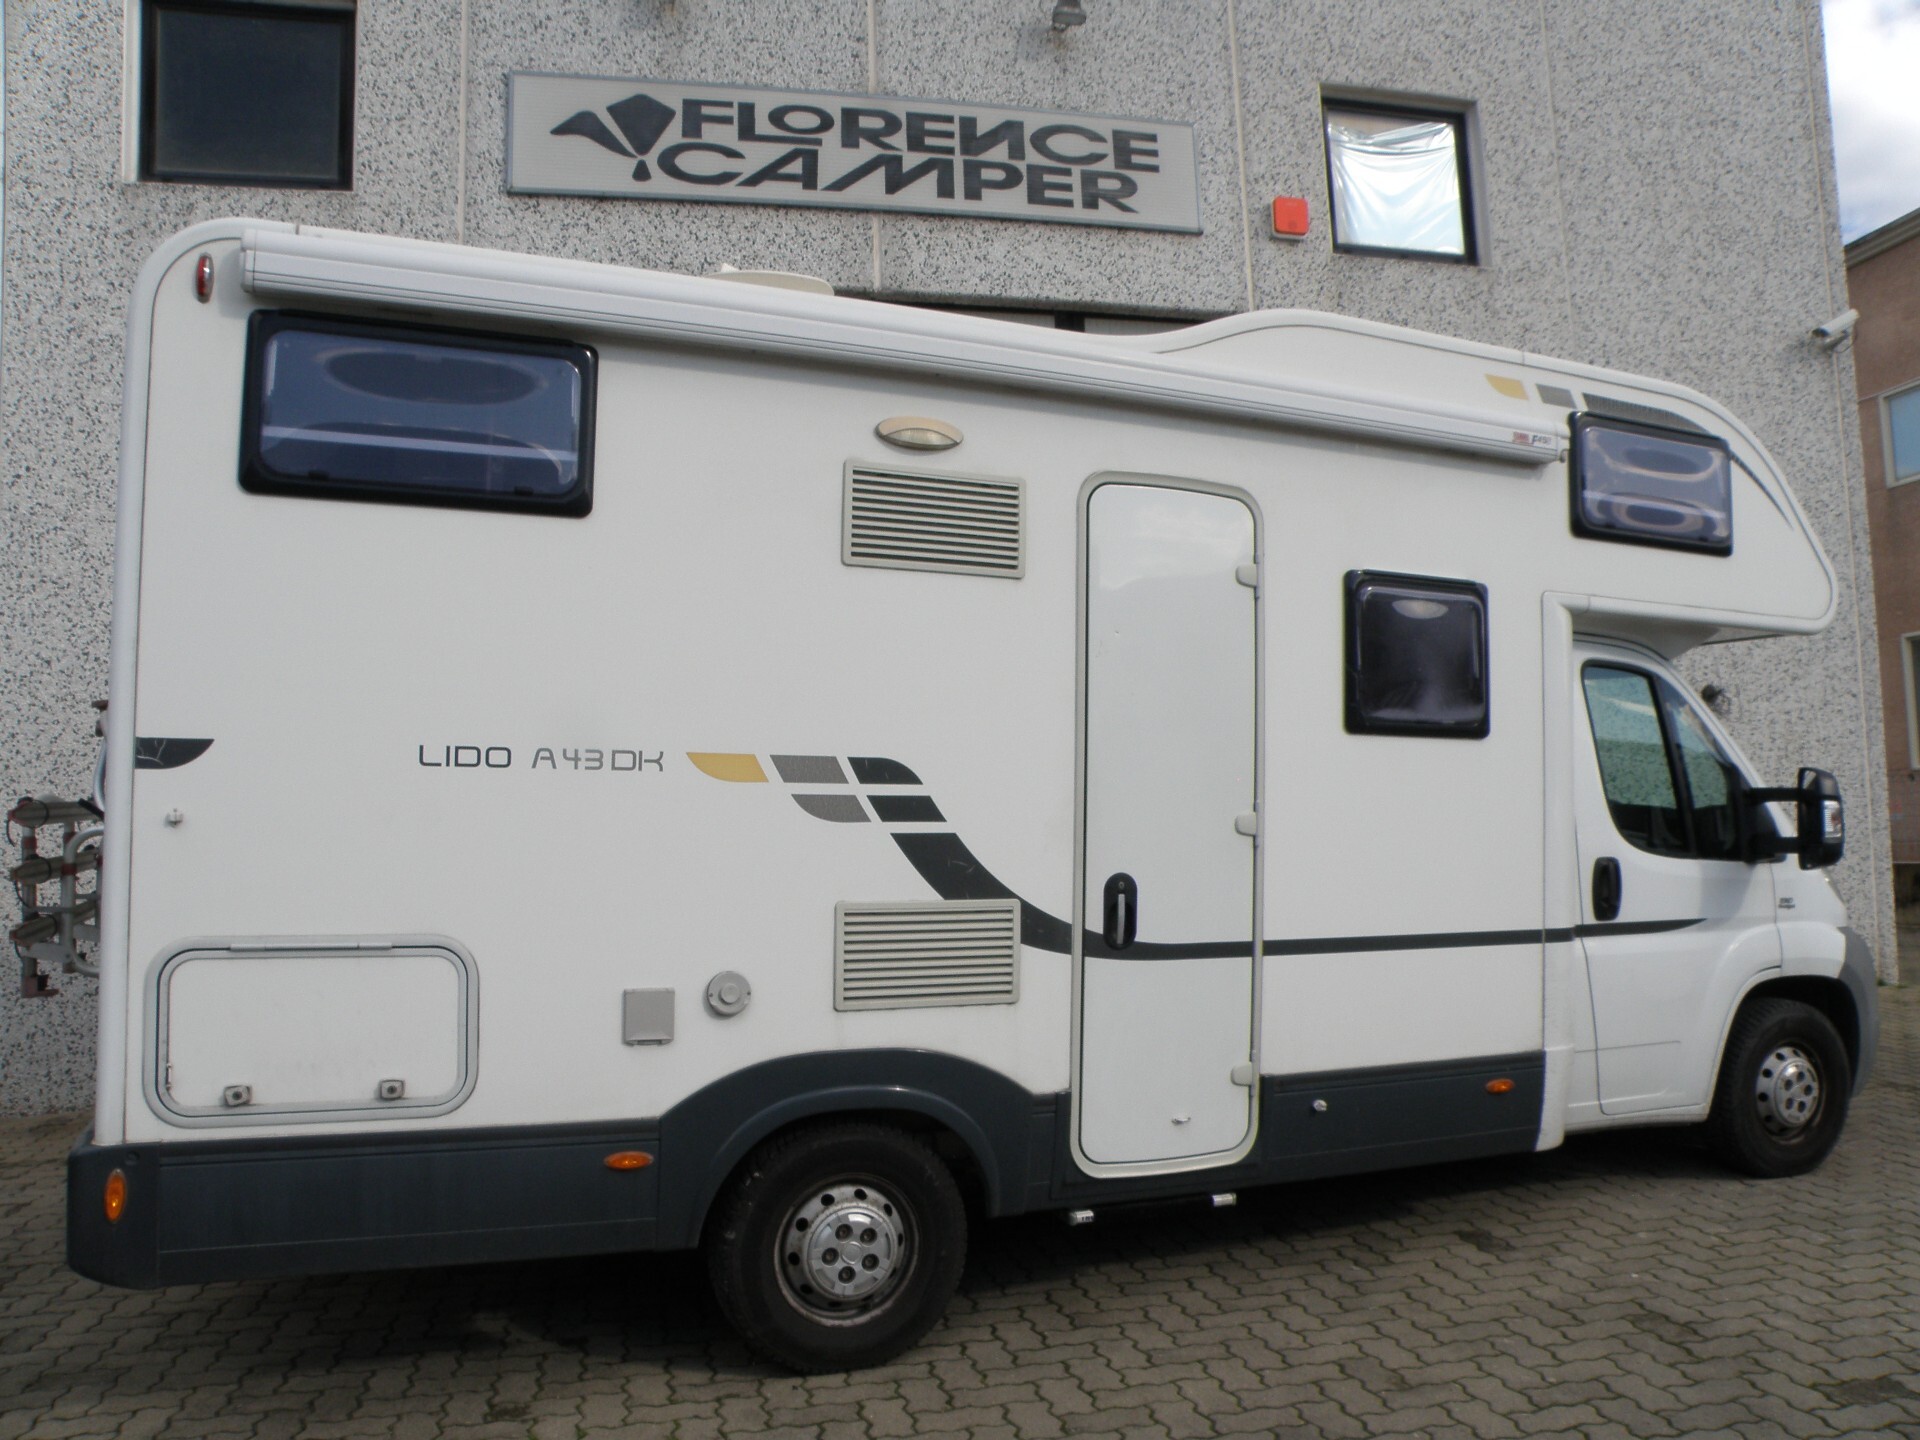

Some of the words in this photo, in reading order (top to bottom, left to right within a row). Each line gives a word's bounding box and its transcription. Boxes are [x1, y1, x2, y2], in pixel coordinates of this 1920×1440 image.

[682, 98, 1159, 172] FLORENCE
[656, 142, 1139, 213] CAMPER
[419, 745, 512, 768] LIDO
